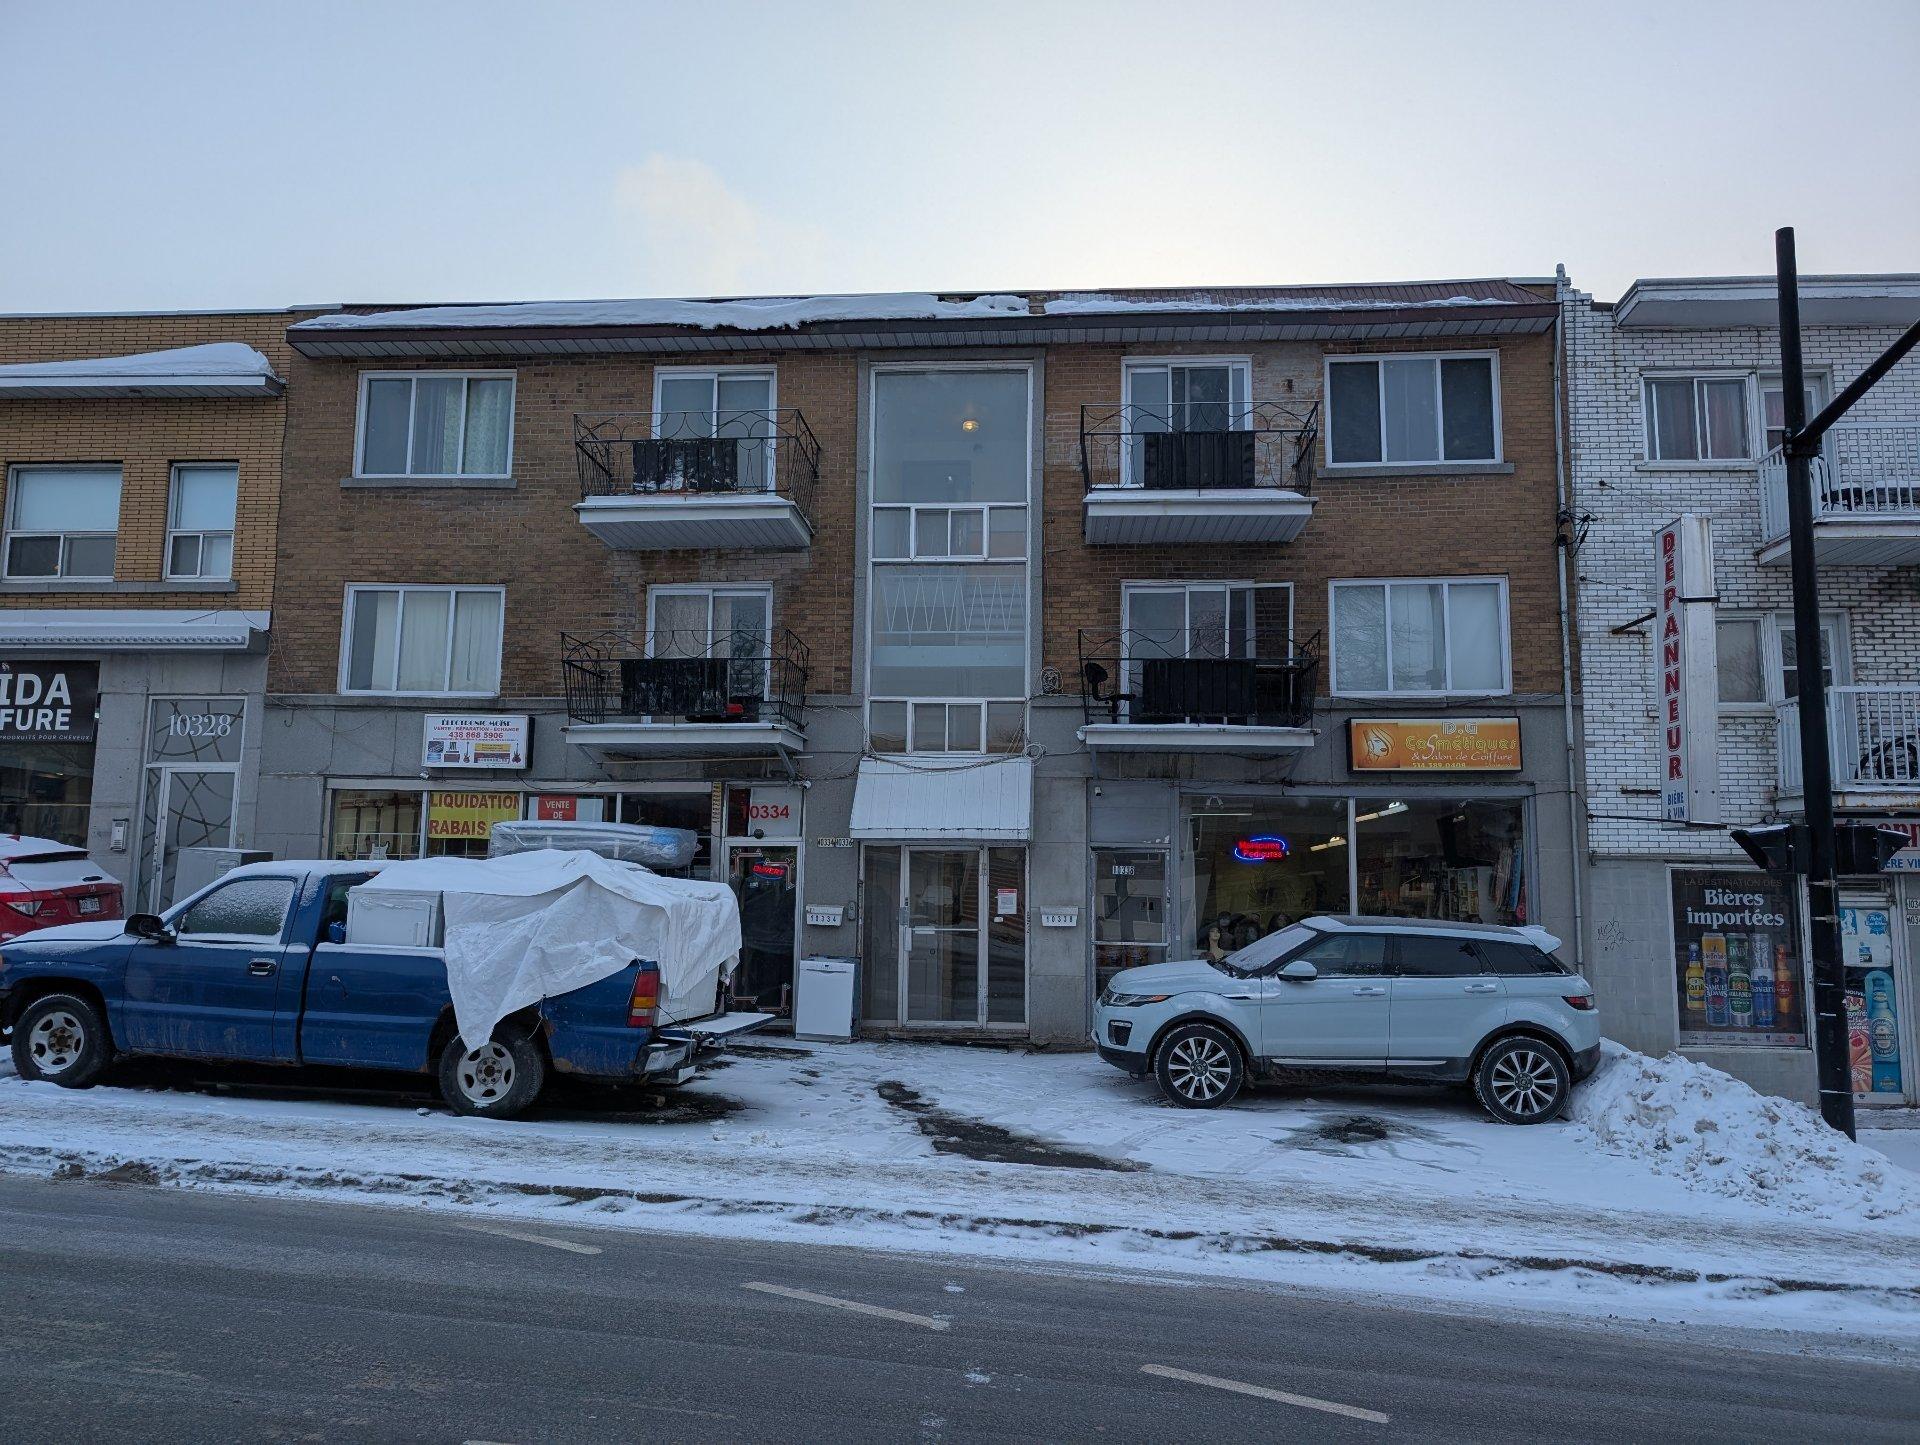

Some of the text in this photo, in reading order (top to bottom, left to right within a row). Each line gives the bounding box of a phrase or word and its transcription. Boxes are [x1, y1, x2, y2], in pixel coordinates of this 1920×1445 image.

[168, 713, 232, 738] 10328
[1456, 751, 1468, 761] de
[1471, 752, 1513, 763] Coiffure
[545, 800, 570, 809] VENTE
[741, 804, 789, 819] 10334
[553, 811, 563, 819] DE
[1673, 806, 1685, 819] VIN
[429, 820, 486, 836] RABAIS
[1704, 888, 1765, 906] Bières
[1686, 907, 1785, 929] importées
